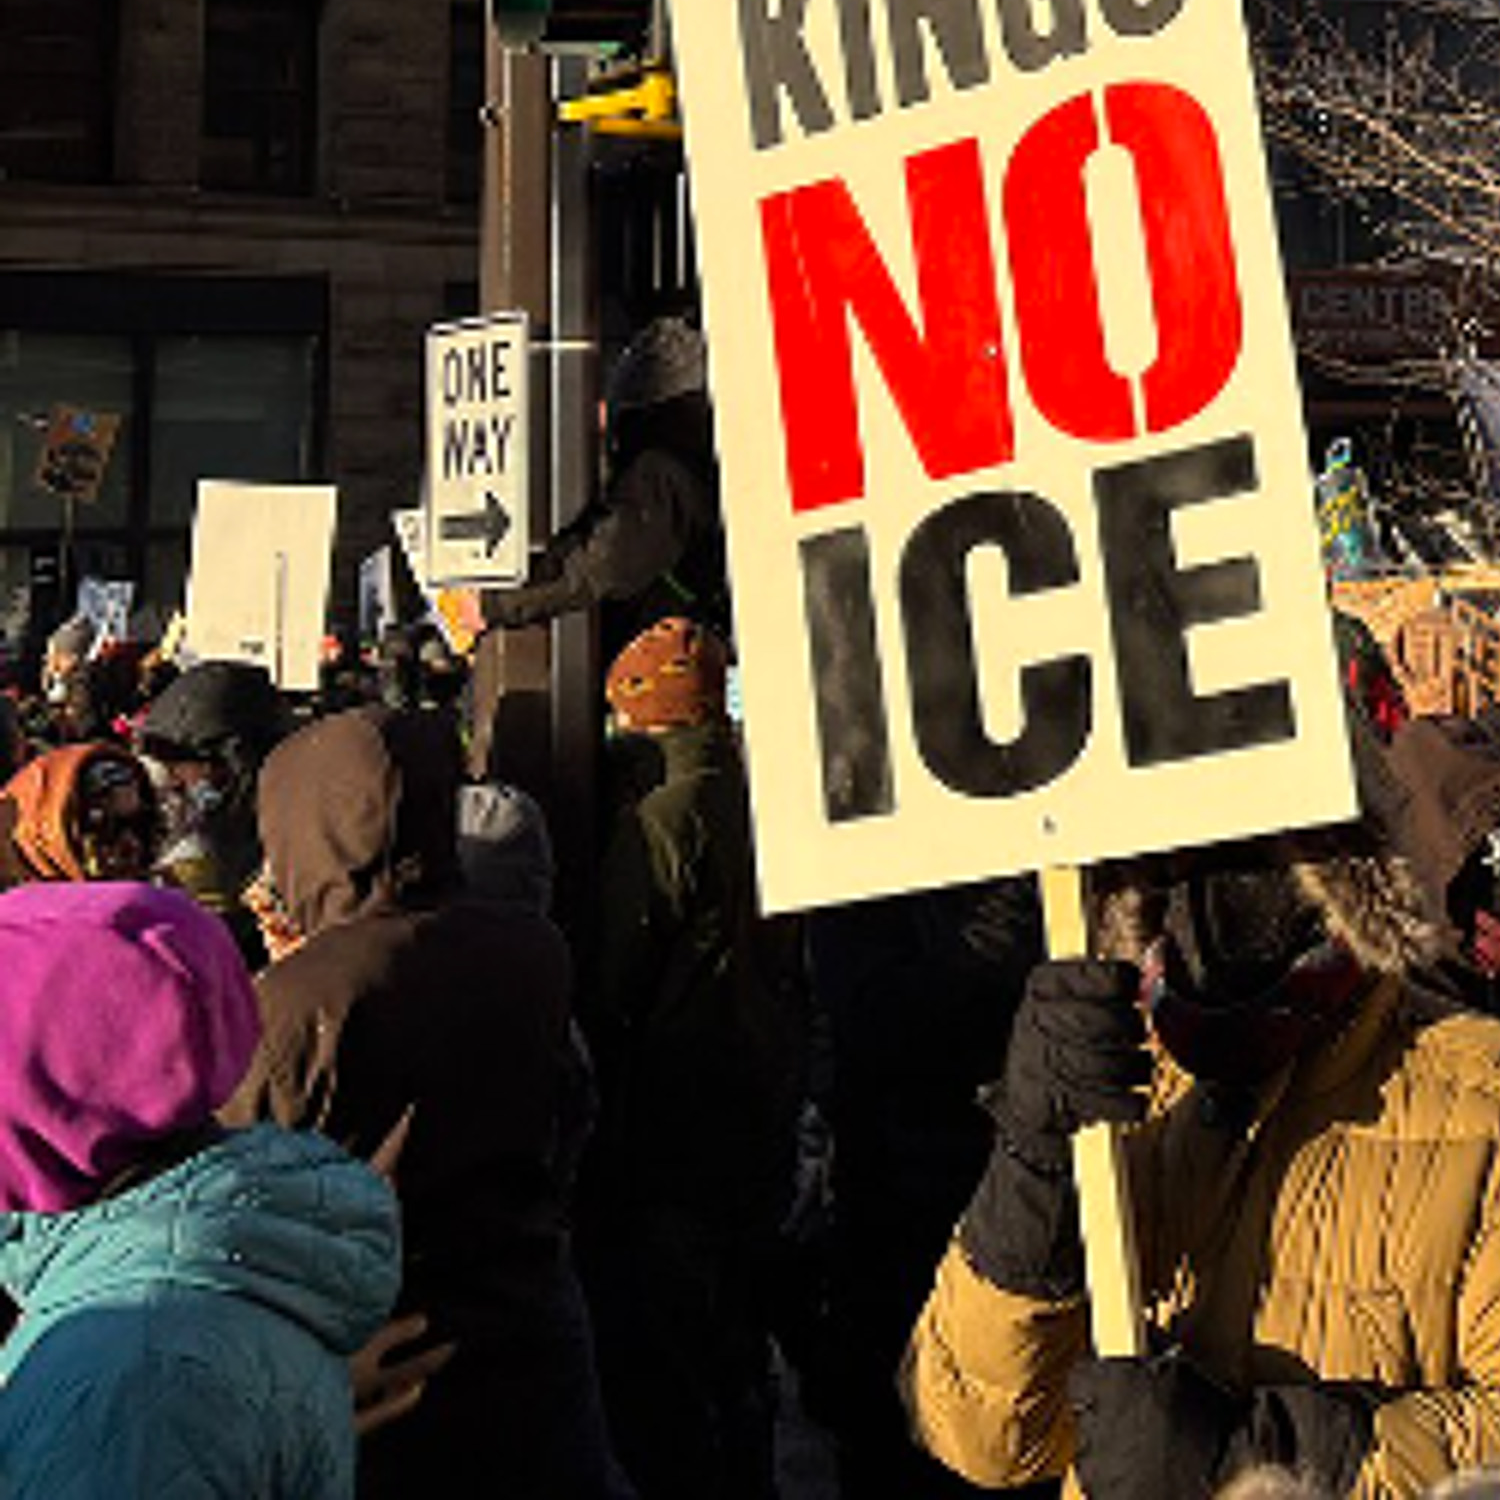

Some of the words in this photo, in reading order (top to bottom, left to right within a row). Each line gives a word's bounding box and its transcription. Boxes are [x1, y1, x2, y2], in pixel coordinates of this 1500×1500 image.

[443, 341, 511, 406] ONE
[757, 80, 1242, 516] NO
[444, 413, 514, 479] WAY
[798, 432, 1298, 825] ICE
